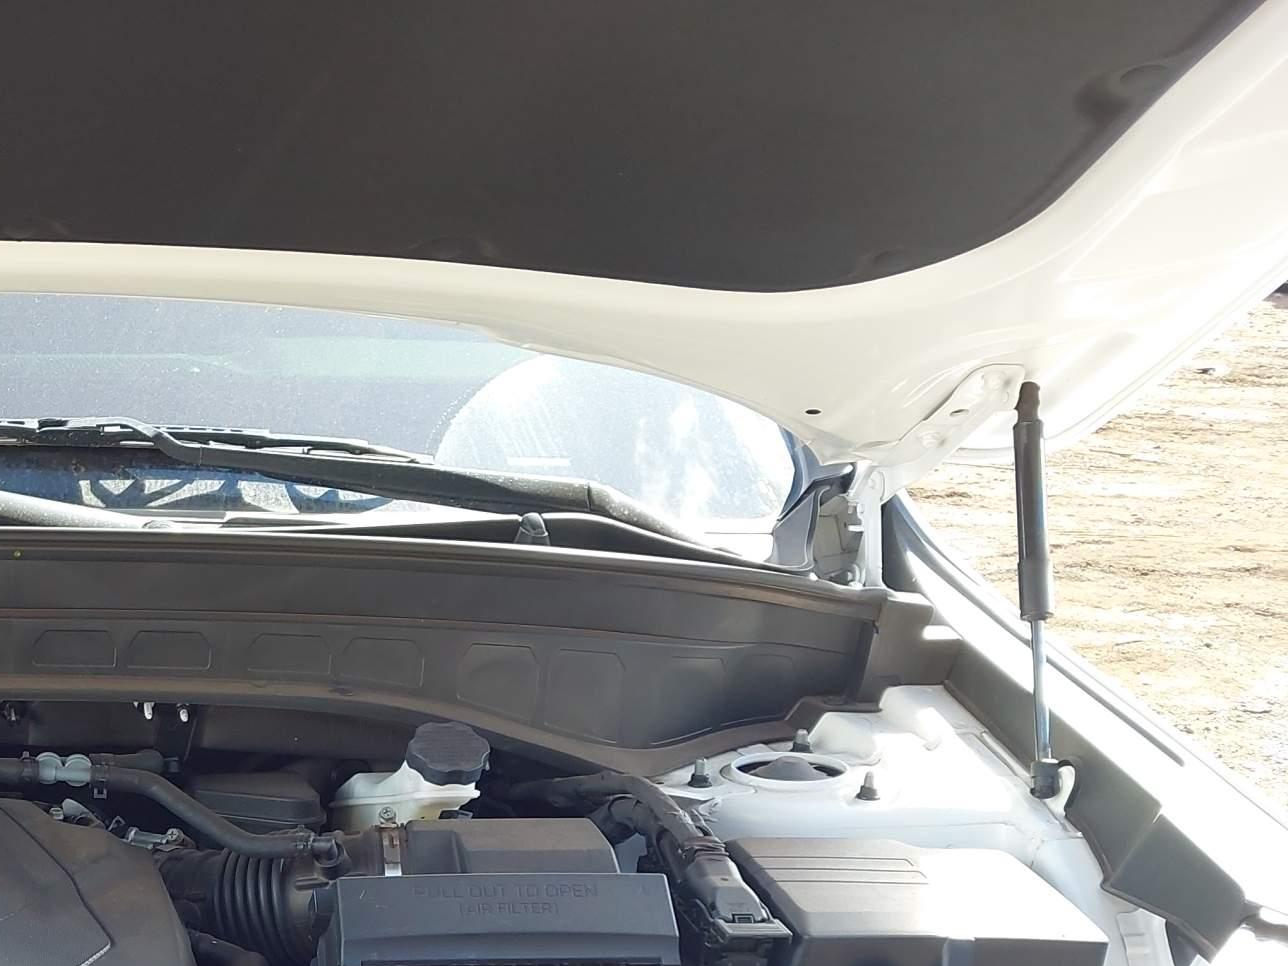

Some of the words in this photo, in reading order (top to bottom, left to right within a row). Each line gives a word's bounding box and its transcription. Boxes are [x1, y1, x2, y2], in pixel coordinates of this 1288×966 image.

[413, 884, 463, 898] PULL
[467, 884, 506, 898] OUT
[513, 884, 540, 898] TO
[544, 884, 599, 898] OPEN
[496, 902, 560, 915] FILTER)
